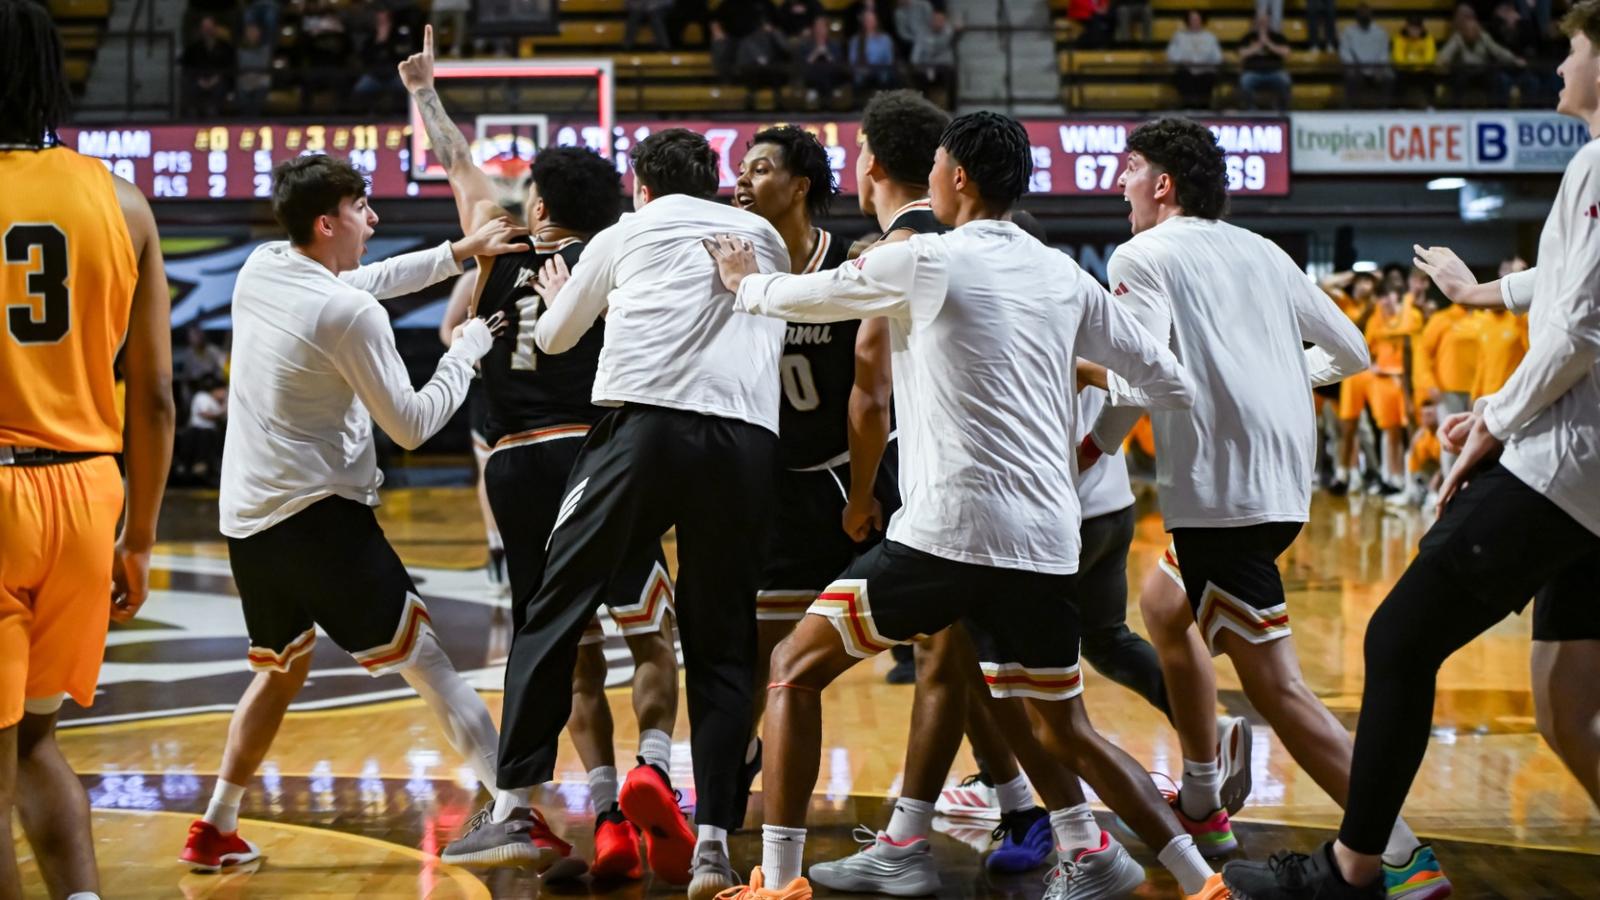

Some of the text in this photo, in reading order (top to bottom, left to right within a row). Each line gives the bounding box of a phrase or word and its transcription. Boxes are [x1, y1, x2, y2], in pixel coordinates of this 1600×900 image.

[77, 130, 151, 158] MIAMI
[1059, 125, 1127, 153] WMU
[1295, 124, 1463, 161] tropical CAFE
[1476, 122, 1508, 162] B
[101, 159, 135, 184] 9
[208, 174, 226, 197] 2
[1074, 155, 1119, 190] 67
[1225, 155, 1265, 190] 69
[4, 221, 72, 346] 3
[510, 295, 541, 371] 1
[780, 354, 820, 411] 0
